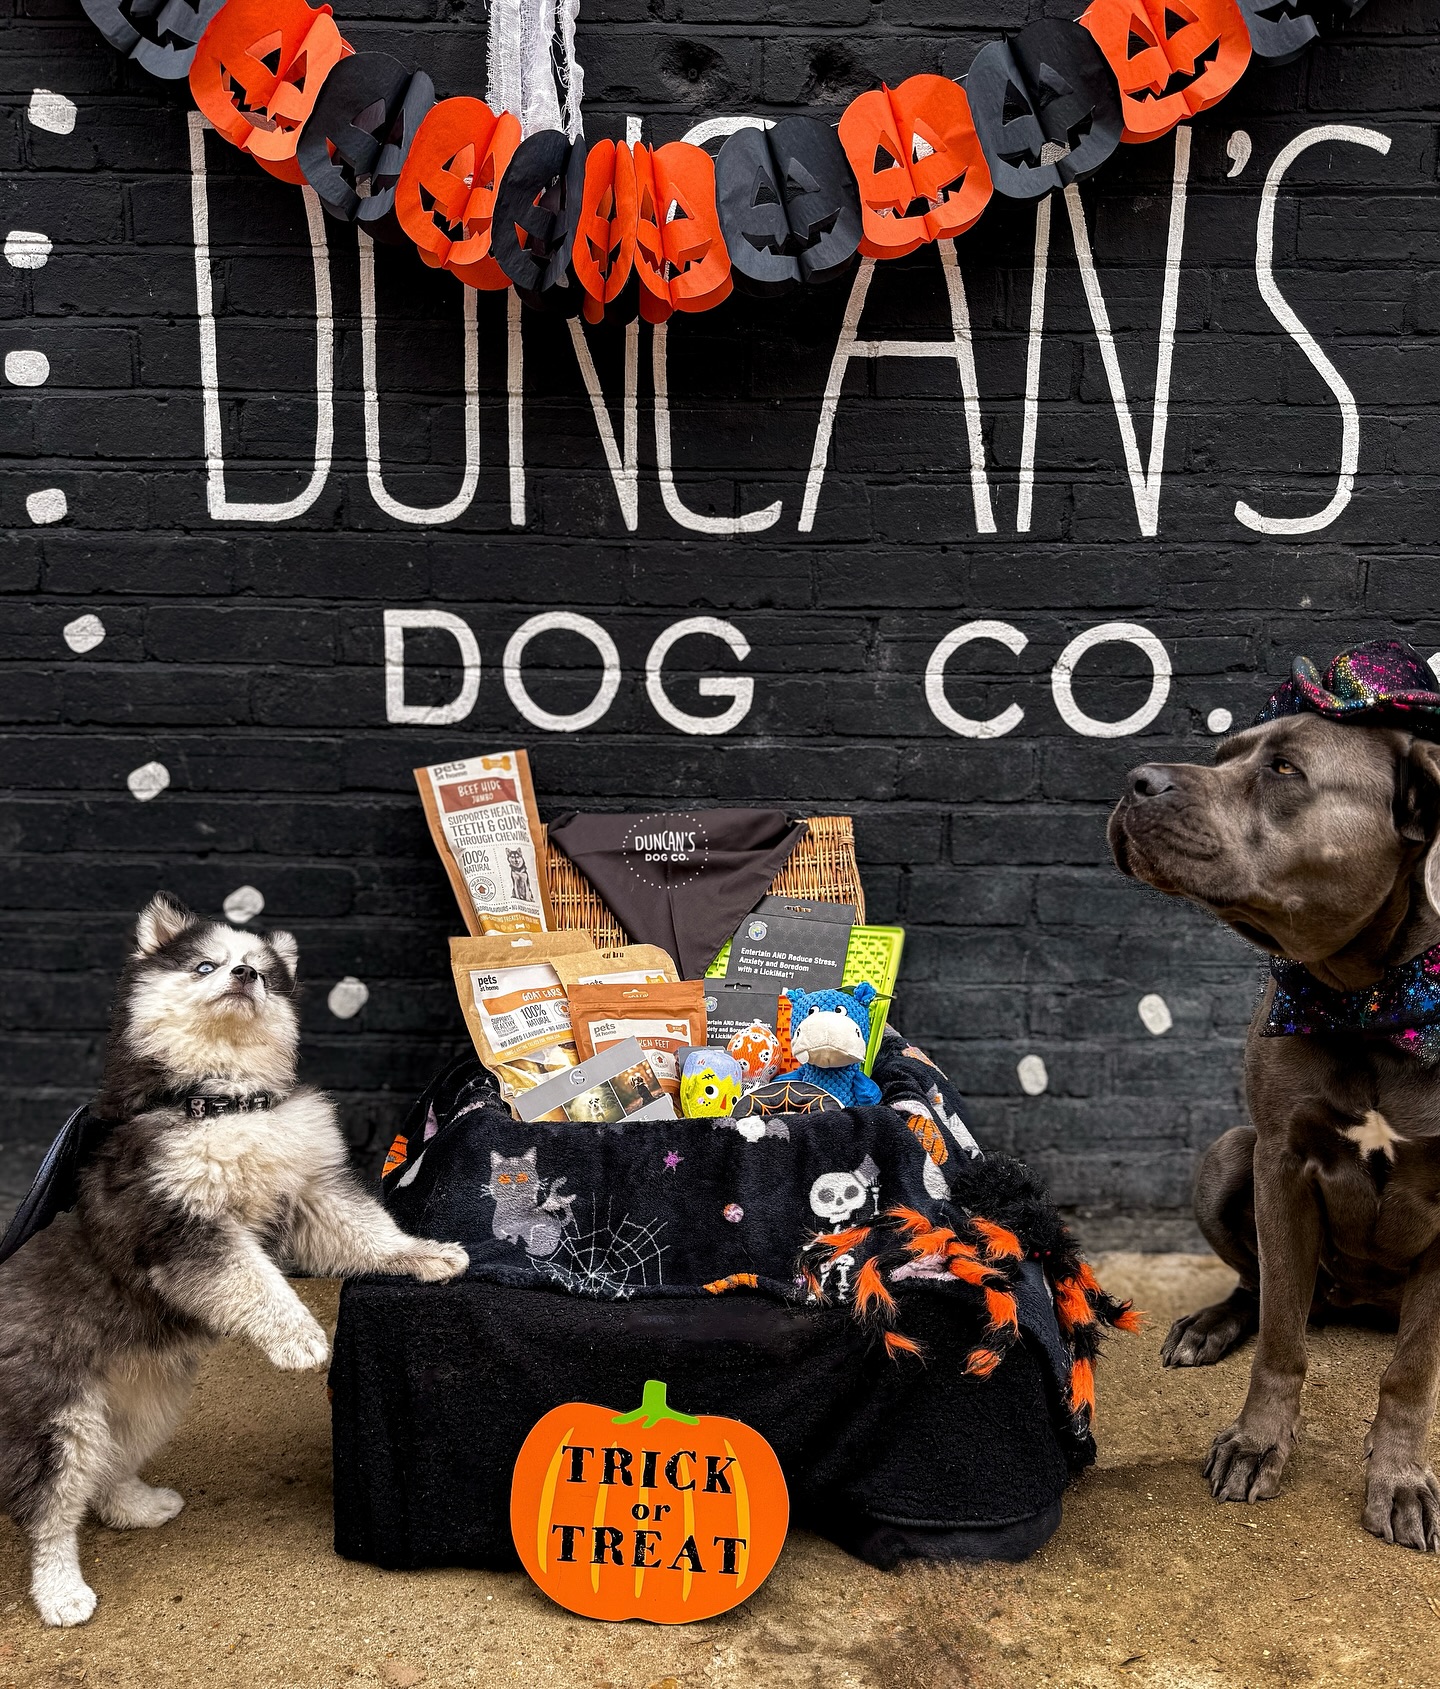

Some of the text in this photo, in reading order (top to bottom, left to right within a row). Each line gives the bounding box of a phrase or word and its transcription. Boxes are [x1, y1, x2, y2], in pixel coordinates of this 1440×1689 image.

[188, 111, 1392, 536] DUNCAN'S
[384, 609, 1233, 739] DOG CO.
[433, 762, 466, 777] pets
[457, 780, 502, 797] BEEF HIDE
[471, 793, 494, 804] JUMBO
[447, 804, 523, 826] SUPPORTS HEALTHY
[450, 816, 527, 837] TEETH & GUMS
[454, 830, 530, 849] THROUGH CHEWING
[635, 830, 696, 852] DUNCAN'S
[462, 849, 490, 867] 100%
[645, 853, 690, 862] DOG CO.
[464, 863, 492, 875] NATURAL
[739, 956, 809, 972] Anxiety and Boredom
[741, 947, 837, 968] Entertain AND Reduce Stress,
[478, 974, 498, 987] pets
[522, 987, 562, 1002] GOAT EARS
[520, 1004, 547, 1020] 100%
[492, 1020, 516, 1032] HEALTHY
[526, 1016, 551, 1028] NATURAL
[593, 1022, 616, 1034] pets
[654, 1039, 670, 1049] FEET
[562, 1445, 737, 1494] TRICK
[631, 1503, 671, 1522] or
[552, 1525, 747, 1575] TREAT
